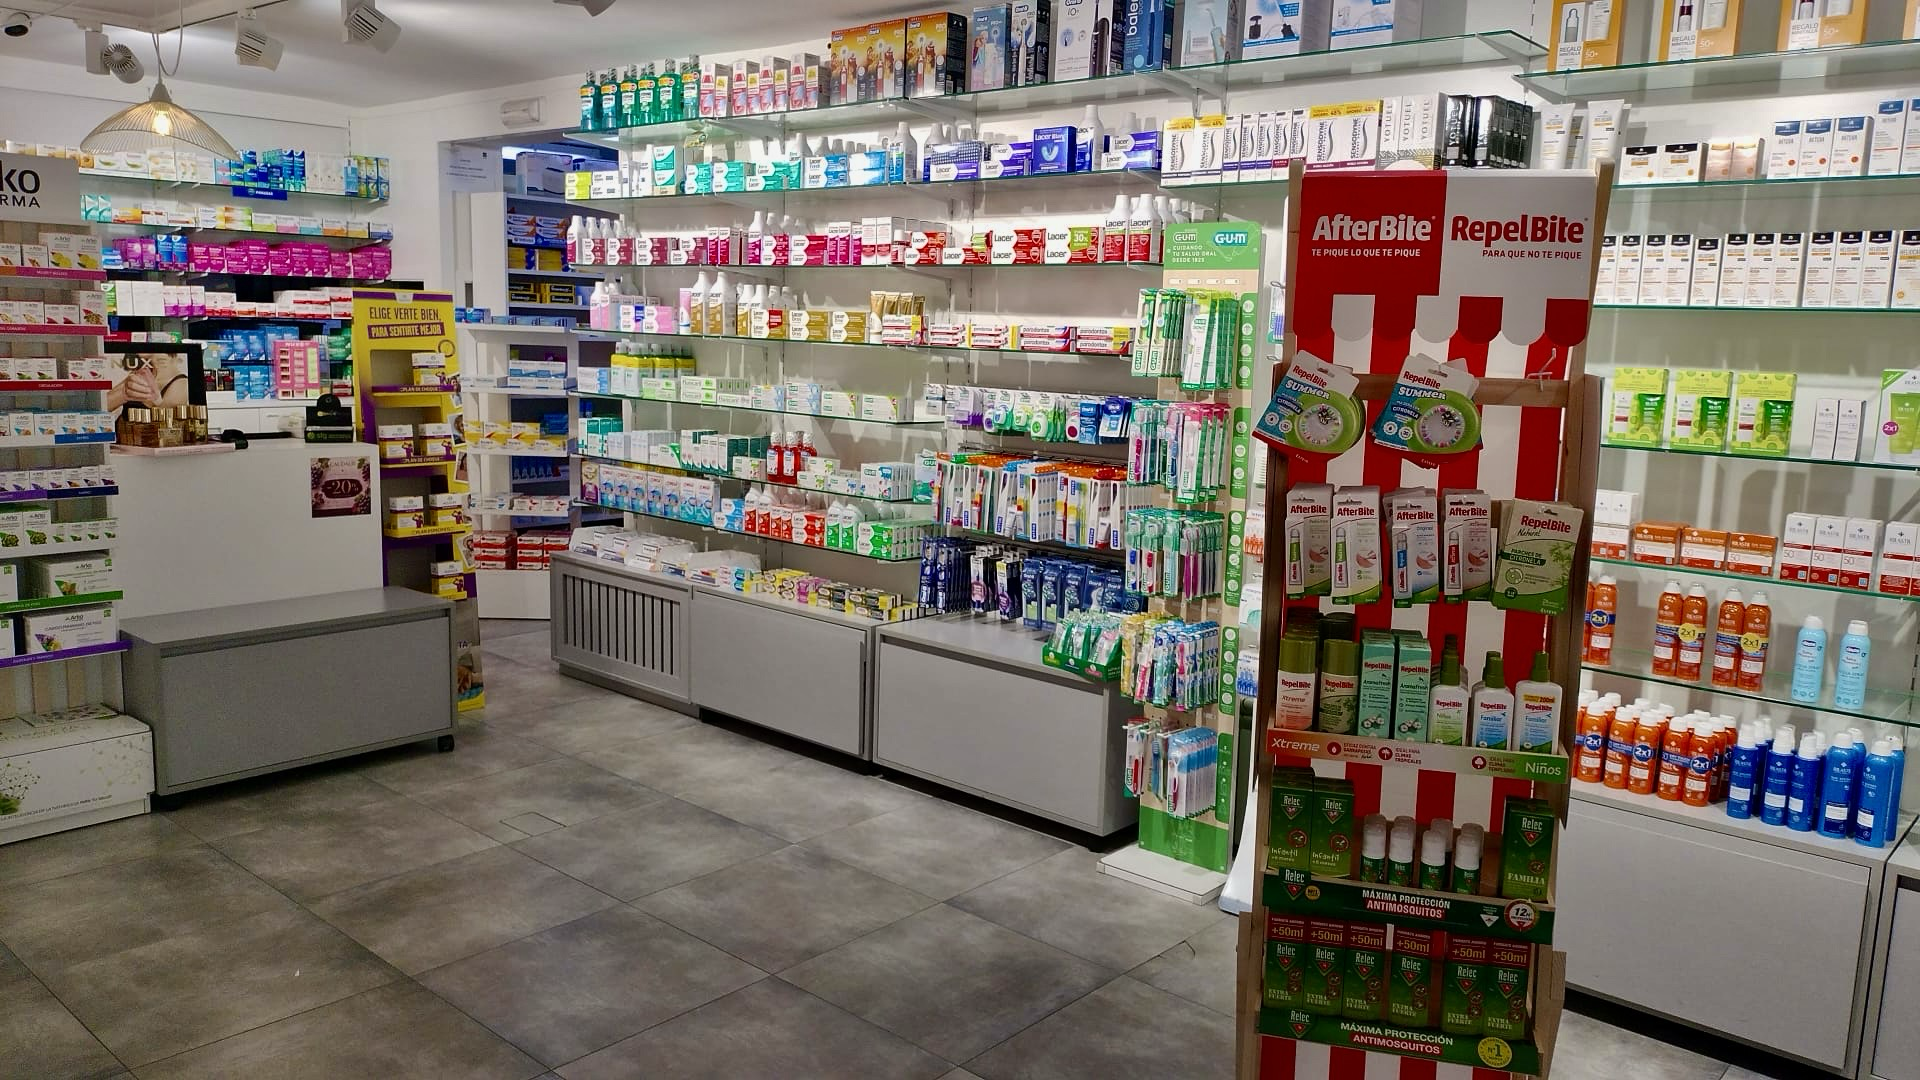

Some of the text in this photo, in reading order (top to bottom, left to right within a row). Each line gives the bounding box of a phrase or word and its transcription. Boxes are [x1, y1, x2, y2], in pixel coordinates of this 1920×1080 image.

[1130, 219, 1151, 227] Lacer
[1312, 213, 1431, 241] AfterBite
[1451, 214, 1584, 247] RepelBite
[994, 234, 1013, 242] Lacer
[1047, 232, 1068, 241] Lacer
[944, 251, 961, 259] Lacer
[993, 251, 1012, 259] Lacer
[1046, 250, 1068, 258] Lacer
[1324, 249, 1348, 257] PIQUE
[1363, 249, 1381, 257] QUE
[1395, 249, 1420, 257] PIQUE
[1482, 250, 1506, 258] PARA
[1508, 250, 1526, 259] QUE
[1542, 251, 1553, 259] TE
[1555, 251, 1582, 260] PIQUE
[369, 307, 391, 319] ELIGE
[394, 307, 418, 320] VERTE
[371, 327, 388, 337] PARA
[390, 325, 419, 336] SENTIRTE
[1292, 364, 1327, 388] RepelBite
[1403, 370, 1441, 389] RepelBite
[1285, 379, 1330, 400] SUMMER
[1398, 386, 1447, 400] SUMMER
[1392, 405, 1419, 420] CITRONELA
[1884, 424, 1897, 432] 2x1
[1290, 504, 1327, 514] AfterBite
[1337, 507, 1375, 517] AfterBite
[1449, 508, 1488, 517] AfterBite
[1396, 511, 1434, 521] AfterBite
[1520, 515, 1571, 533] RepelBite
[1516, 528, 1542, 537] Natural
[1509, 554, 1542, 566] CITRONELA
[1813, 553, 1825, 561] 50
[1844, 556, 1855, 565] 50
[1591, 613, 1608, 624] 2x1
[1680, 628, 1696, 637] 2x1
[1743, 637, 1760, 647] 2x1
[1281, 679, 1312, 689] RepelBite
[1325, 680, 1354, 689] RepelBite
[1480, 702, 1507, 710] RepelBite
[1271, 738, 1320, 751] Xtreme
[1586, 738, 1602, 746] 2x1
[1634, 748, 1652, 757] 2x1
[1525, 762, 1561, 775] Niños
[1692, 760, 1710, 769] 2x1
[1283, 795, 1301, 806] Relec
[1325, 799, 1343, 811] Relec
[1522, 817, 1543, 831] Relec
[1271, 848, 1298, 857] Infantil
[1312, 851, 1340, 862] Infantil
[1285, 869, 1305, 882] Relec
[1507, 872, 1545, 885] FAMILIA
[1362, 888, 1450, 909] MÁXIMA PROTECCIÓN
[1272, 927, 1303, 938] +50ml
[1311, 930, 1343, 942] +50ml
[1351, 935, 1383, 946] +50ml
[1277, 943, 1296, 956] Relec
[1397, 940, 1430, 953] +50ml
[1316, 948, 1335, 960] Relec
[1355, 952, 1375, 965] Relec
[1453, 949, 1486, 959] +50ml
[1493, 952, 1527, 963] +50ml
[1401, 957, 1421, 971] Relec
[1457, 965, 1477, 978] Relec
[1498, 970, 1518, 983] Relec
[1290, 1010, 1310, 1023] Relec
[1341, 1022, 1453, 1046] MÁXIMA PROTECCIÓN
[1353, 1034, 1440, 1054] ANTIMOSQUITOS
